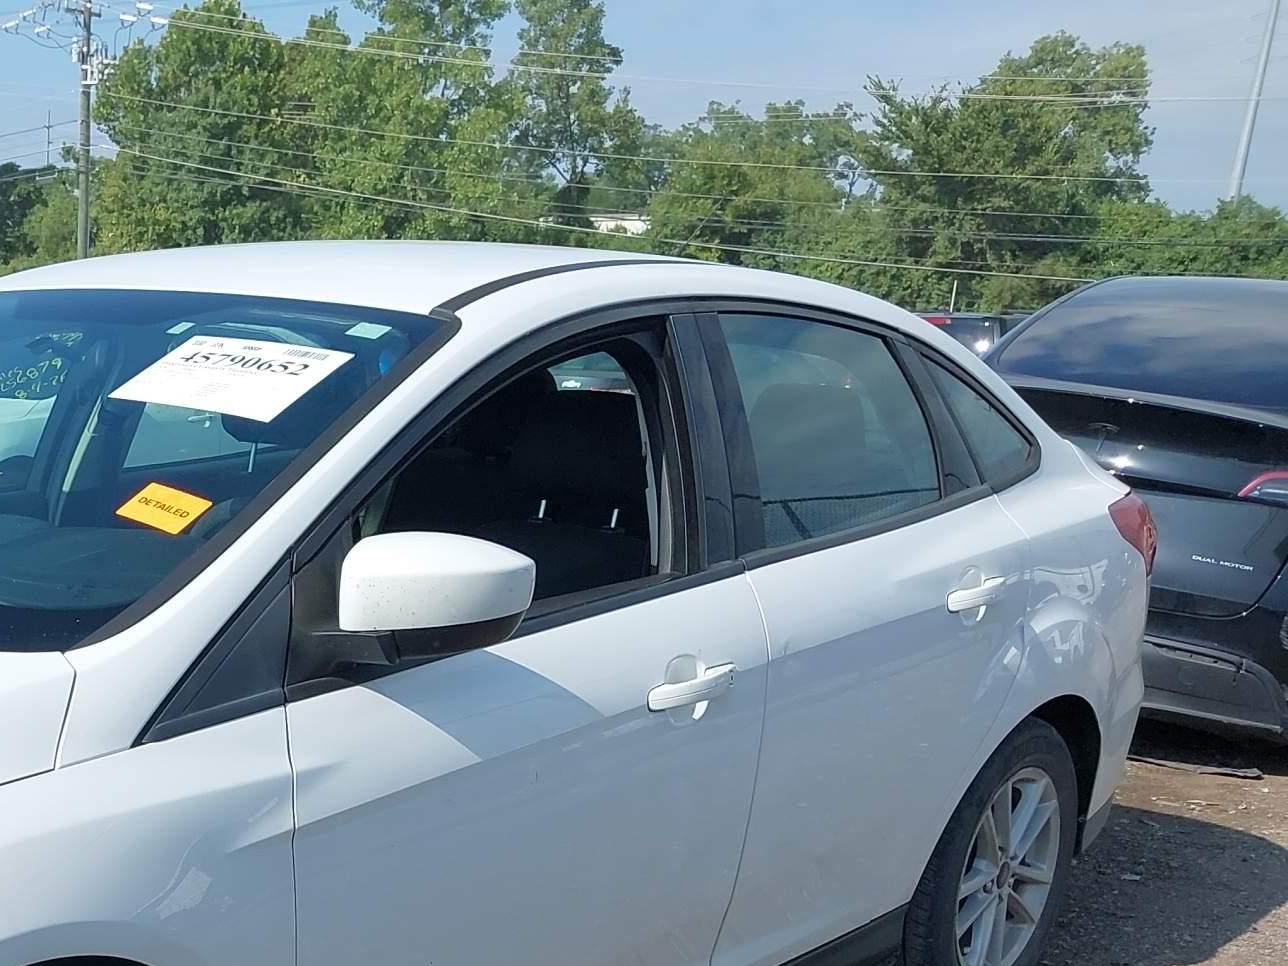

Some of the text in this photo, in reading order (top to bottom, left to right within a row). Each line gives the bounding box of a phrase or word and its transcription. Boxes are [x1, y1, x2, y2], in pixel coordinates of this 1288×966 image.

[180, 350, 311, 377] 45790652
[137, 496, 190, 519] DETAILED
[1192, 555, 1254, 571] DUAL MOTOR
